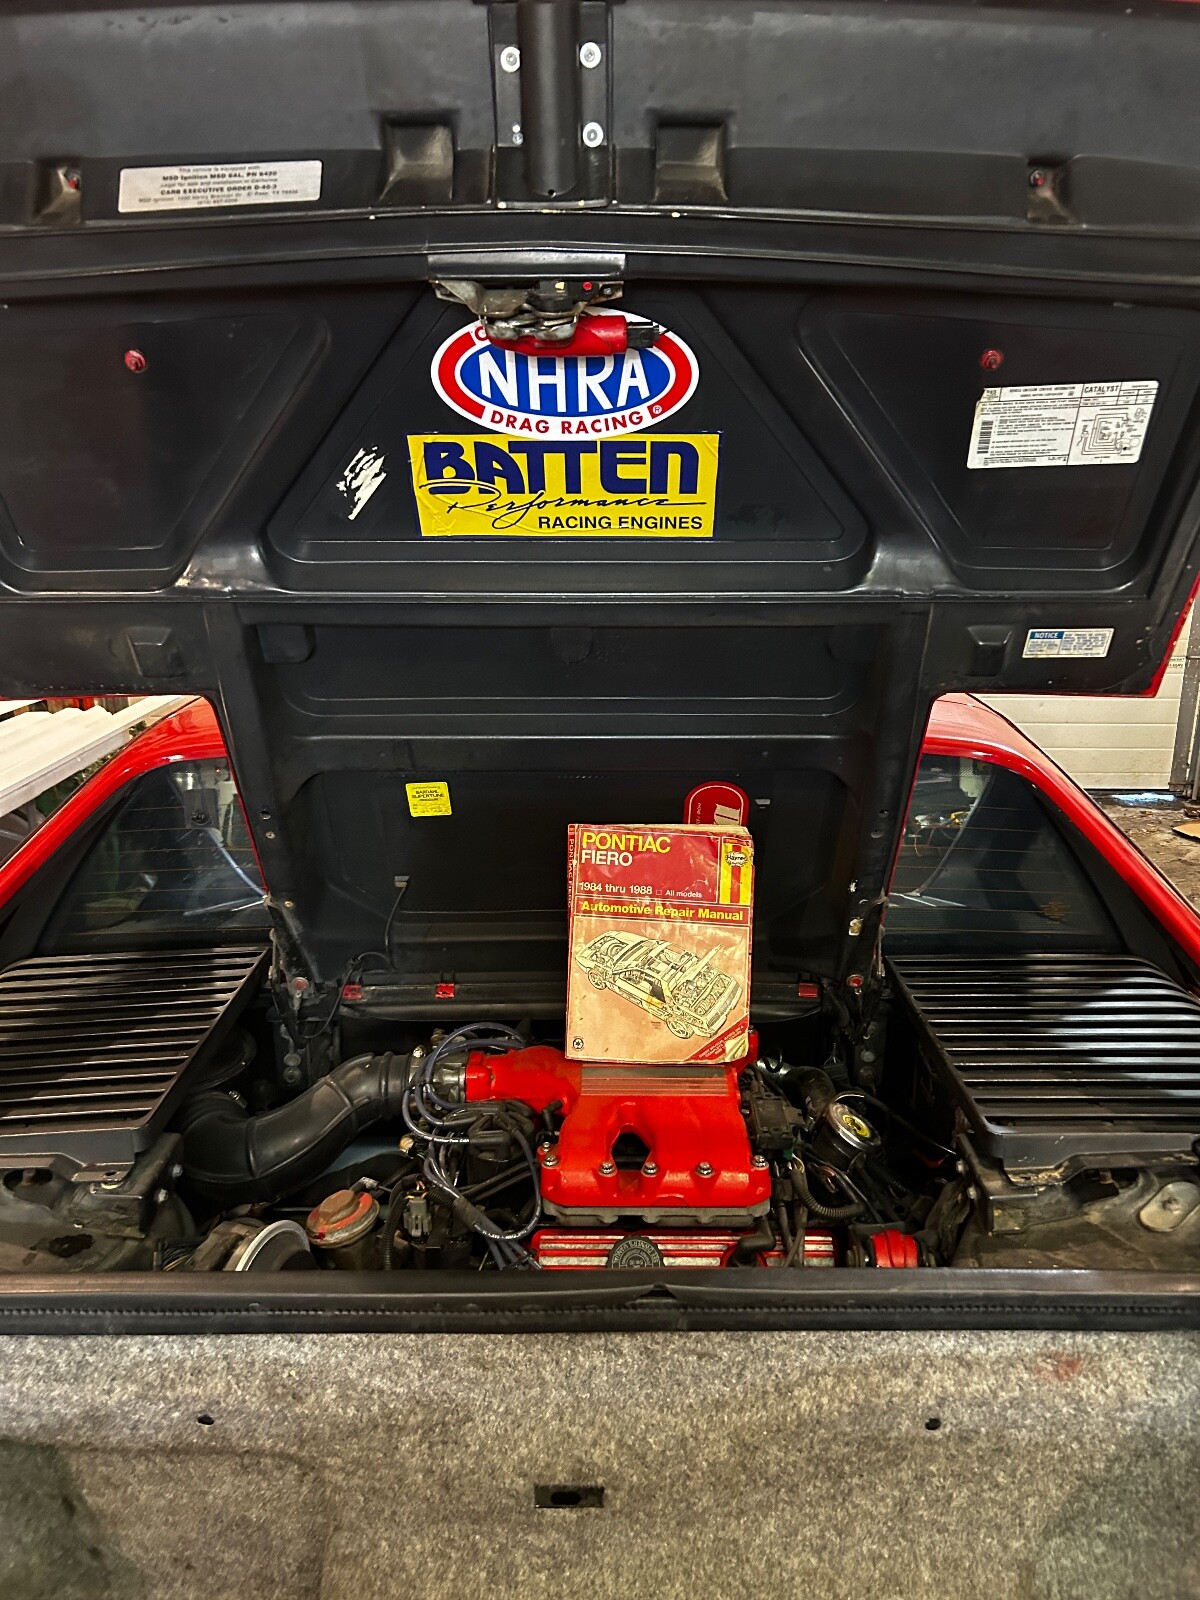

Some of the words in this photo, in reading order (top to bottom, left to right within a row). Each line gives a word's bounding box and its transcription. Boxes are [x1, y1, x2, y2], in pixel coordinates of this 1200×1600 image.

[183, 186, 224, 194] EXECUTIVE
[478, 349, 650, 413] NHRA
[1084, 385, 1119, 393] CATALYST
[490, 410, 550, 434] DRAG
[561, 410, 644, 434] RACING
[423, 440, 699, 494] BATTEN
[419, 478, 707, 529] Performance
[538, 516, 612, 529] RACING
[618, 516, 703, 529] ENGINES
[582, 832, 671, 854] PONTIAC
[580, 850, 633, 866] FIERO
[579, 881, 602, 892] 1984
[605, 883, 626, 893] thru
[630, 884, 652, 895] 1988
[676, 890, 702, 898] models
[581, 901, 650, 916] Automotive
[654, 903, 695, 918] Repair
[698, 908, 743, 921] Manual
